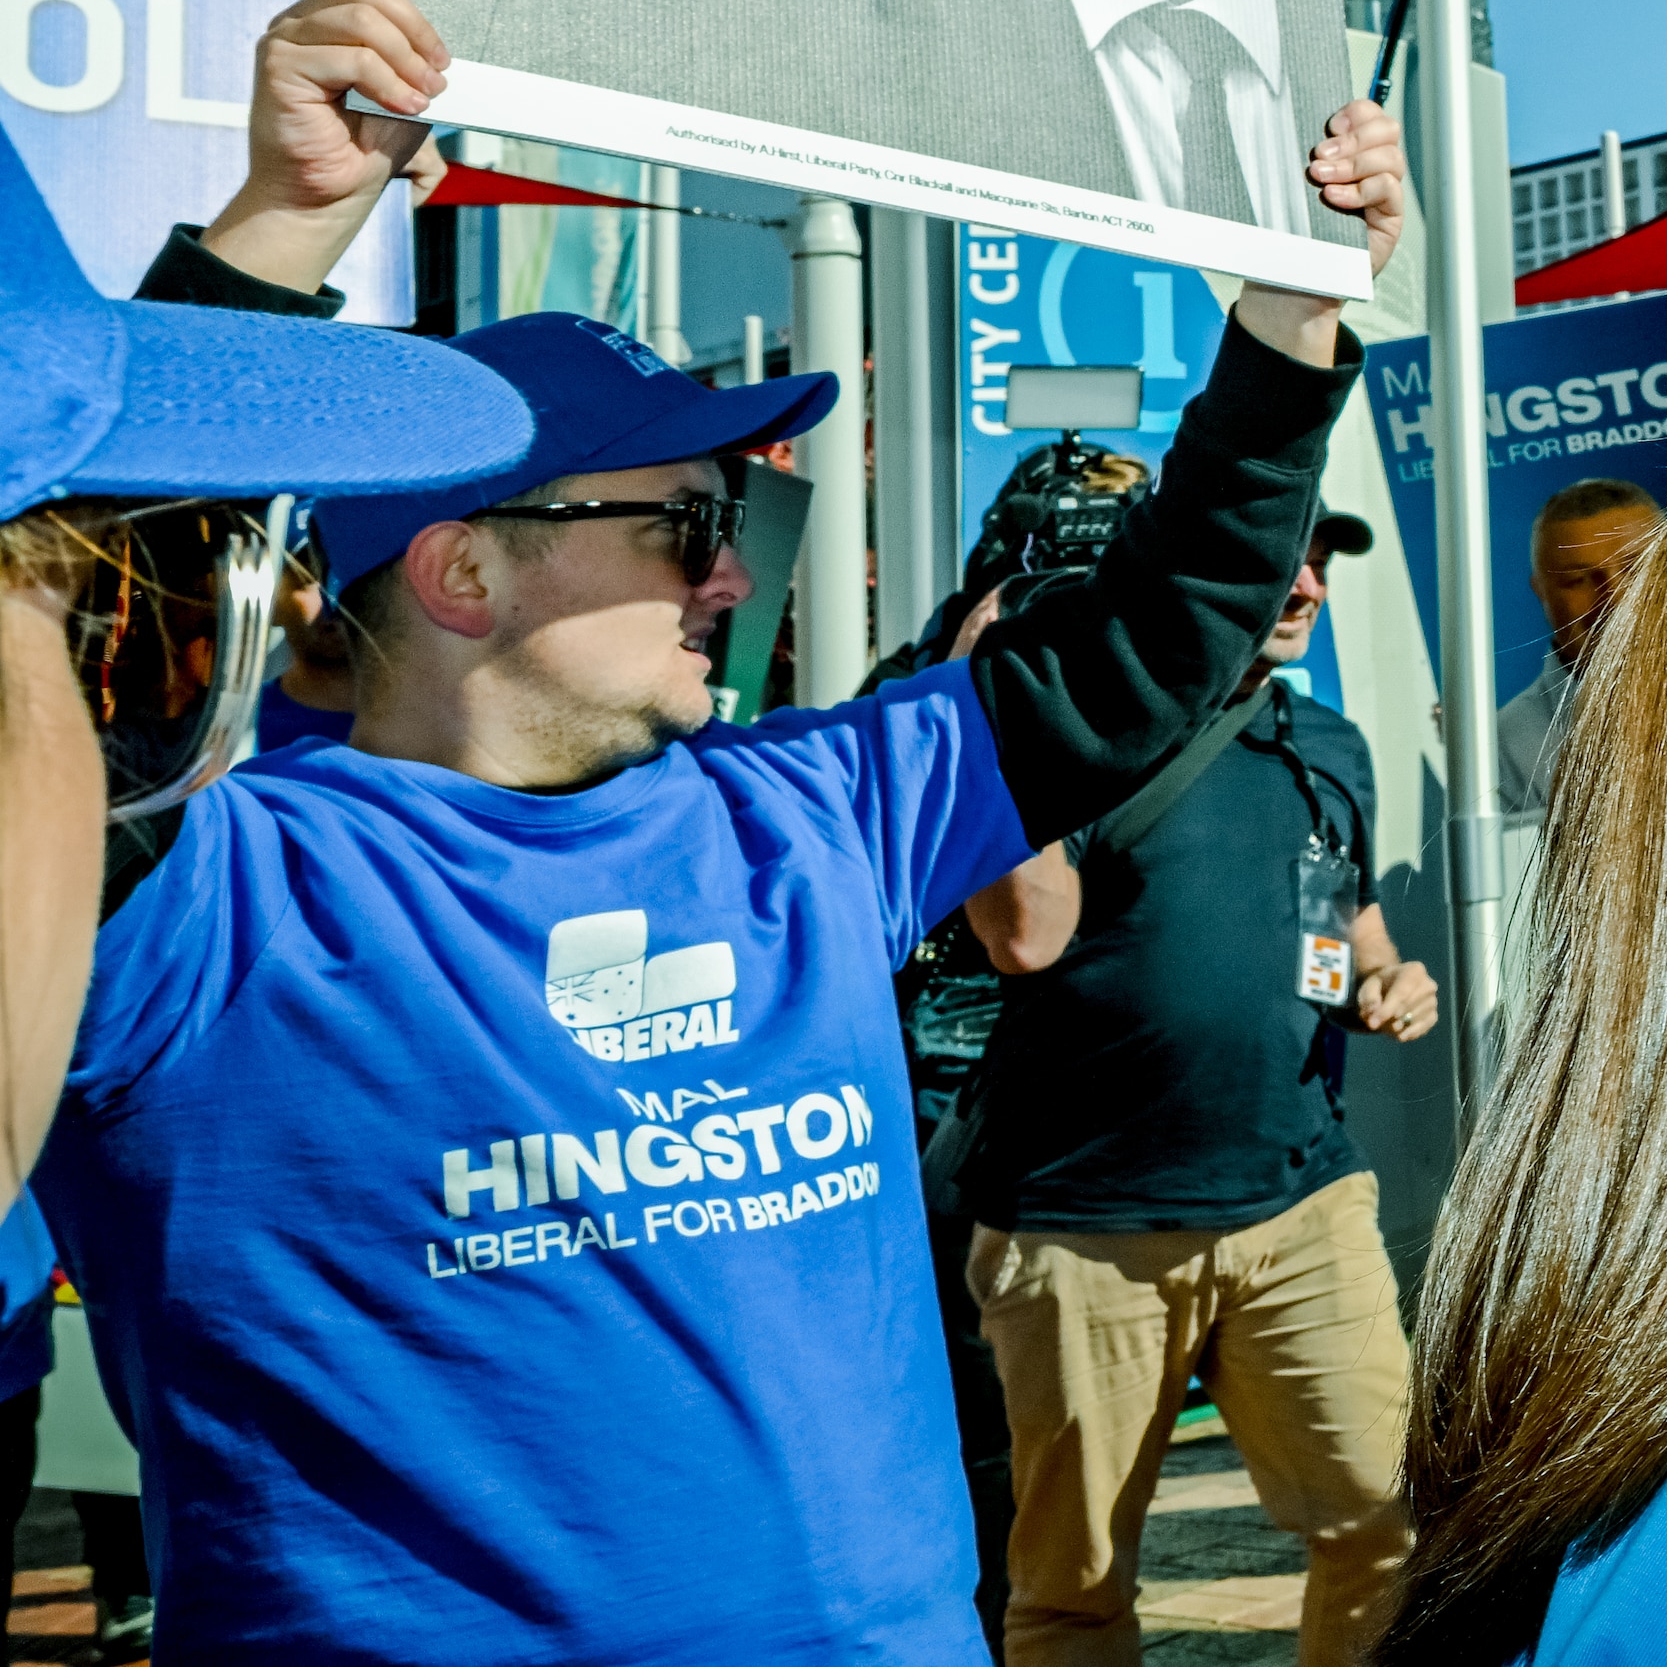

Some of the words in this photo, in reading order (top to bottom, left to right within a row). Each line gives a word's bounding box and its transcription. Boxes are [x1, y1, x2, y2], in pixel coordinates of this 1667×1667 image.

[666, 125, 738, 150] Authorised
[740, 139, 756, 155] by
[806, 153, 847, 172] Liberal
[884, 168, 905, 184] Cnr
[909, 174, 953, 193] Blackall
[955, 184, 977, 198] and
[979, 188, 1039, 211] Macquarie
[1063, 206, 1100, 223] Barton
[1101, 213, 1124, 228] ACT
[968, 223, 1020, 306] CE
[970, 317, 1021, 437] CITY
[1397, 447, 1506, 483] LIBL
[1508, 436, 1564, 465] FOR
[615, 1078, 749, 1123] MAL
[426, 1213, 636, 1279] LIBERAL
[644, 1199, 737, 1243] FOR
